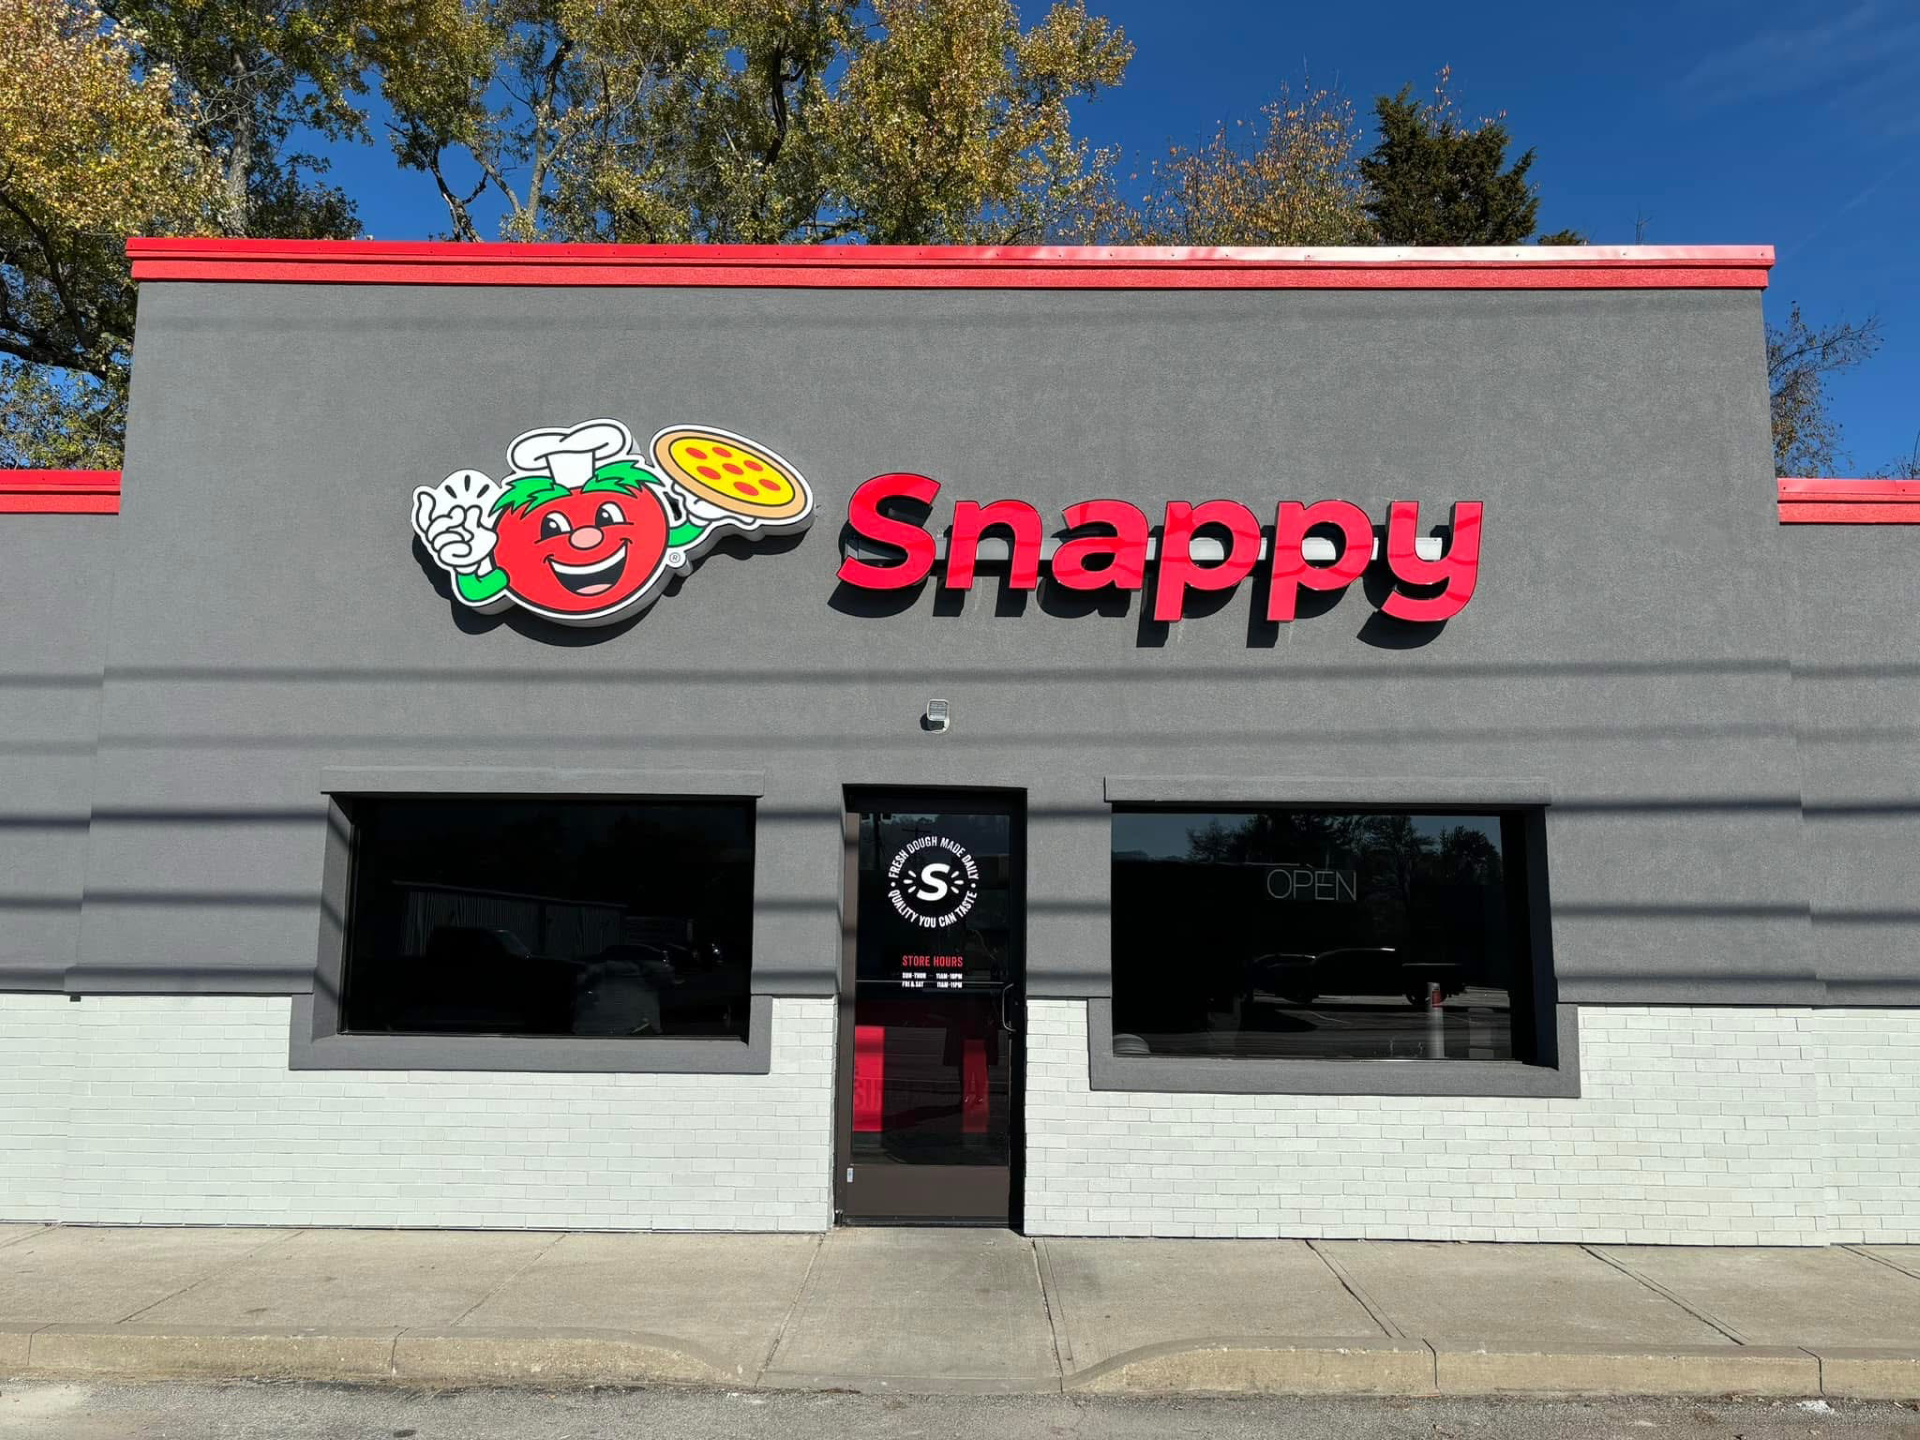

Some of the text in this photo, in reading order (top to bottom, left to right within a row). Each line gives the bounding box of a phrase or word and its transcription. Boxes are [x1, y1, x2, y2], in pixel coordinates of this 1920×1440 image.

[835, 472, 1484, 622] Snappy
[888, 836, 979, 880] FRESH DOUGH MADE DAILY
[917, 863, 951, 901] S
[1267, 869, 1357, 901] OPEN
[888, 889, 978, 928] QUALITY YOU CAN TASTE
[902, 955, 963, 967] STORE HOURS
